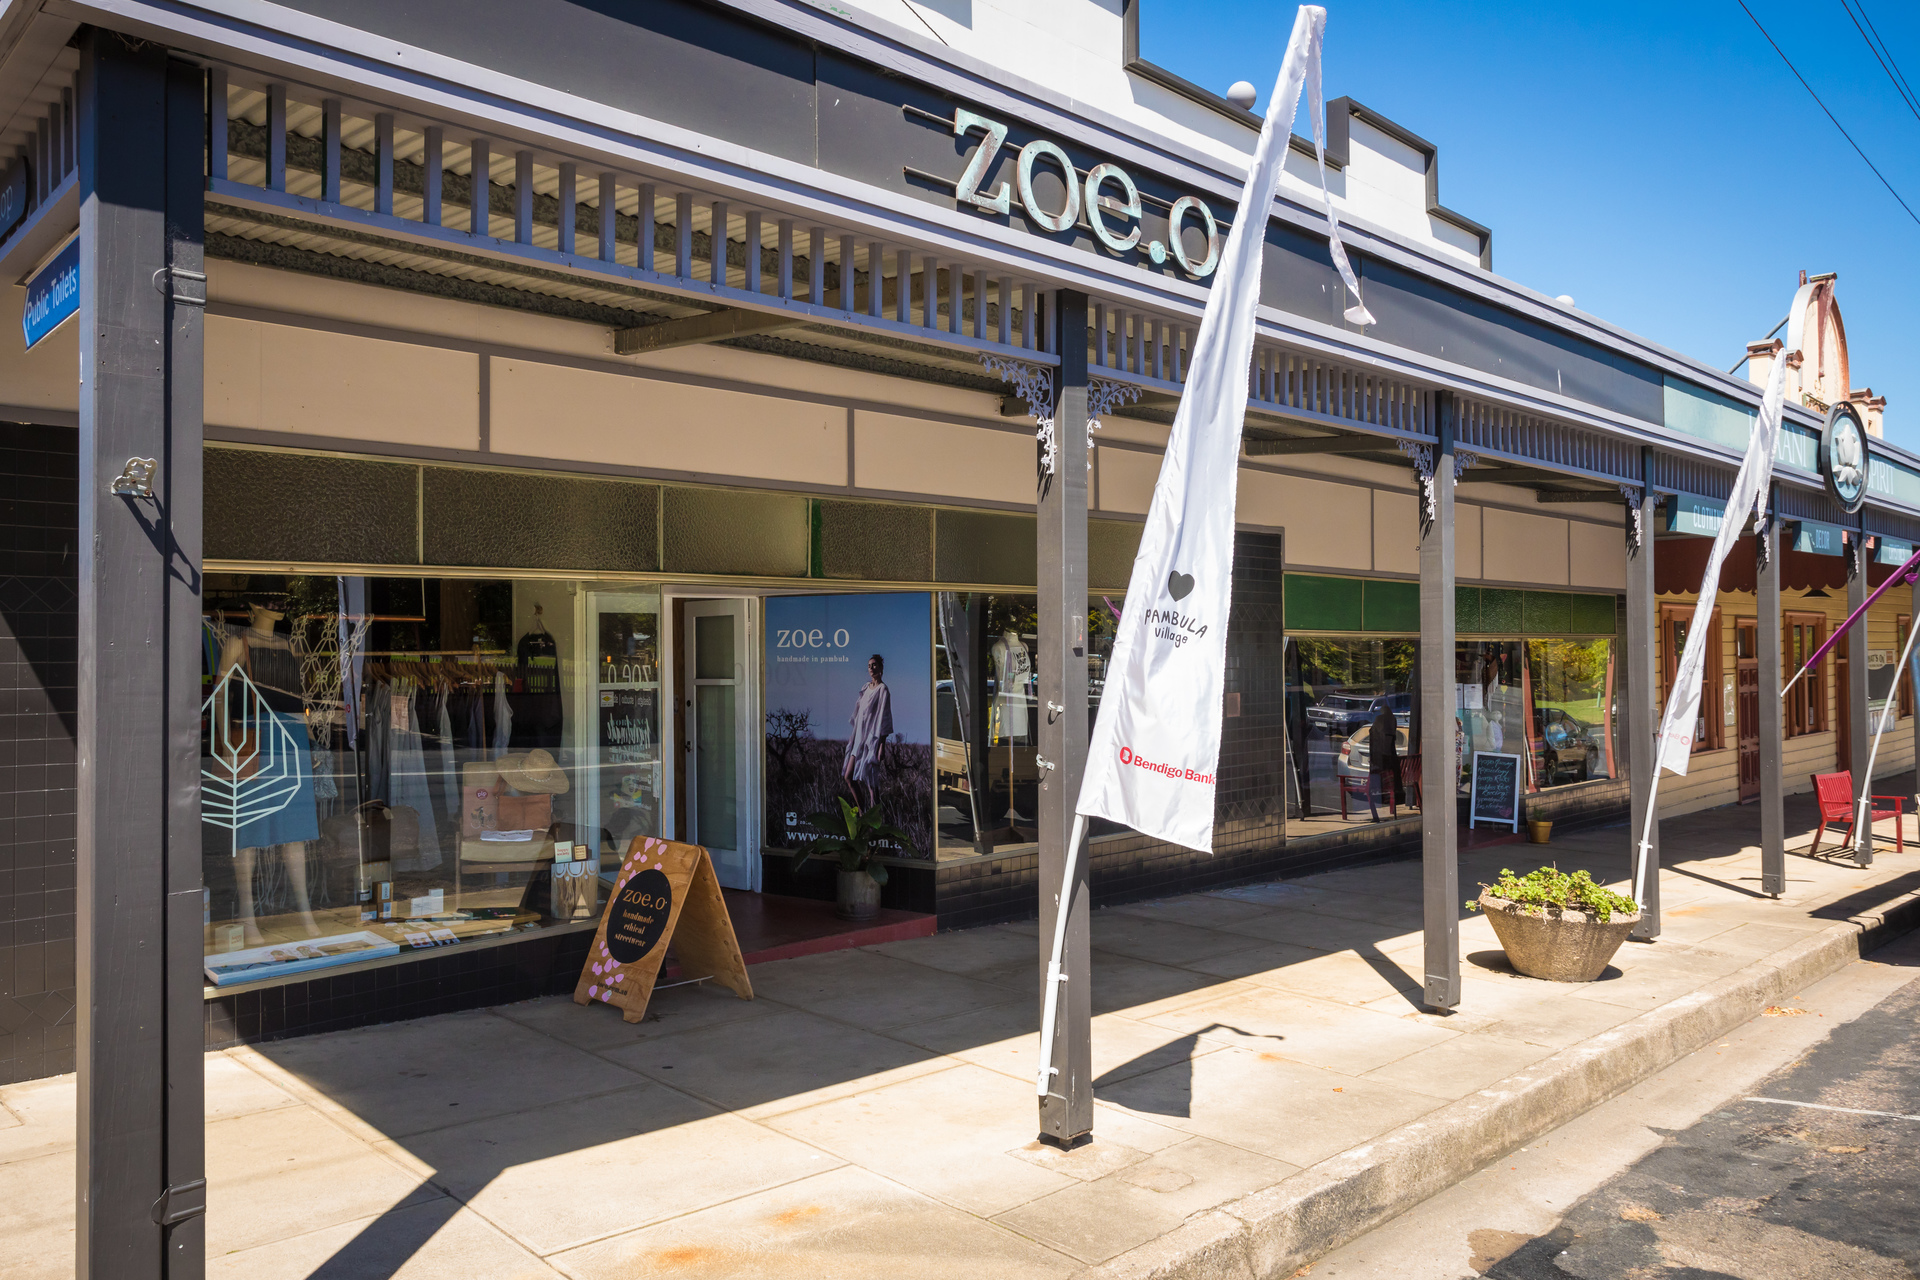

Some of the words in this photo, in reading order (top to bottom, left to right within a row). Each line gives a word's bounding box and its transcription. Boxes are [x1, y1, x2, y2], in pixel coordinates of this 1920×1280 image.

[953, 107, 1220, 277] zoe.o
[26, 288, 49, 331] Public
[51, 265, 77, 309] Toilets
[1868, 458, 1894, 495] PIRIT
[1815, 529, 1830, 550] DECOR
[1144, 608, 1208, 638] PAMBULA
[776, 628, 850, 648] zoe.o
[1154, 626, 1188, 648] village
[776, 655, 810, 663] handmade
[811, 655, 819, 663] in
[820, 655, 849, 664] pambula
[1133, 755, 1183, 779] Bendigo
[1184, 768, 1216, 785] Bank
[622, 889, 666, 910] zoe.o
[622, 909, 655, 924] handmade
[623, 922, 646, 935] ethical
[614, 933, 646, 947] streetwear
